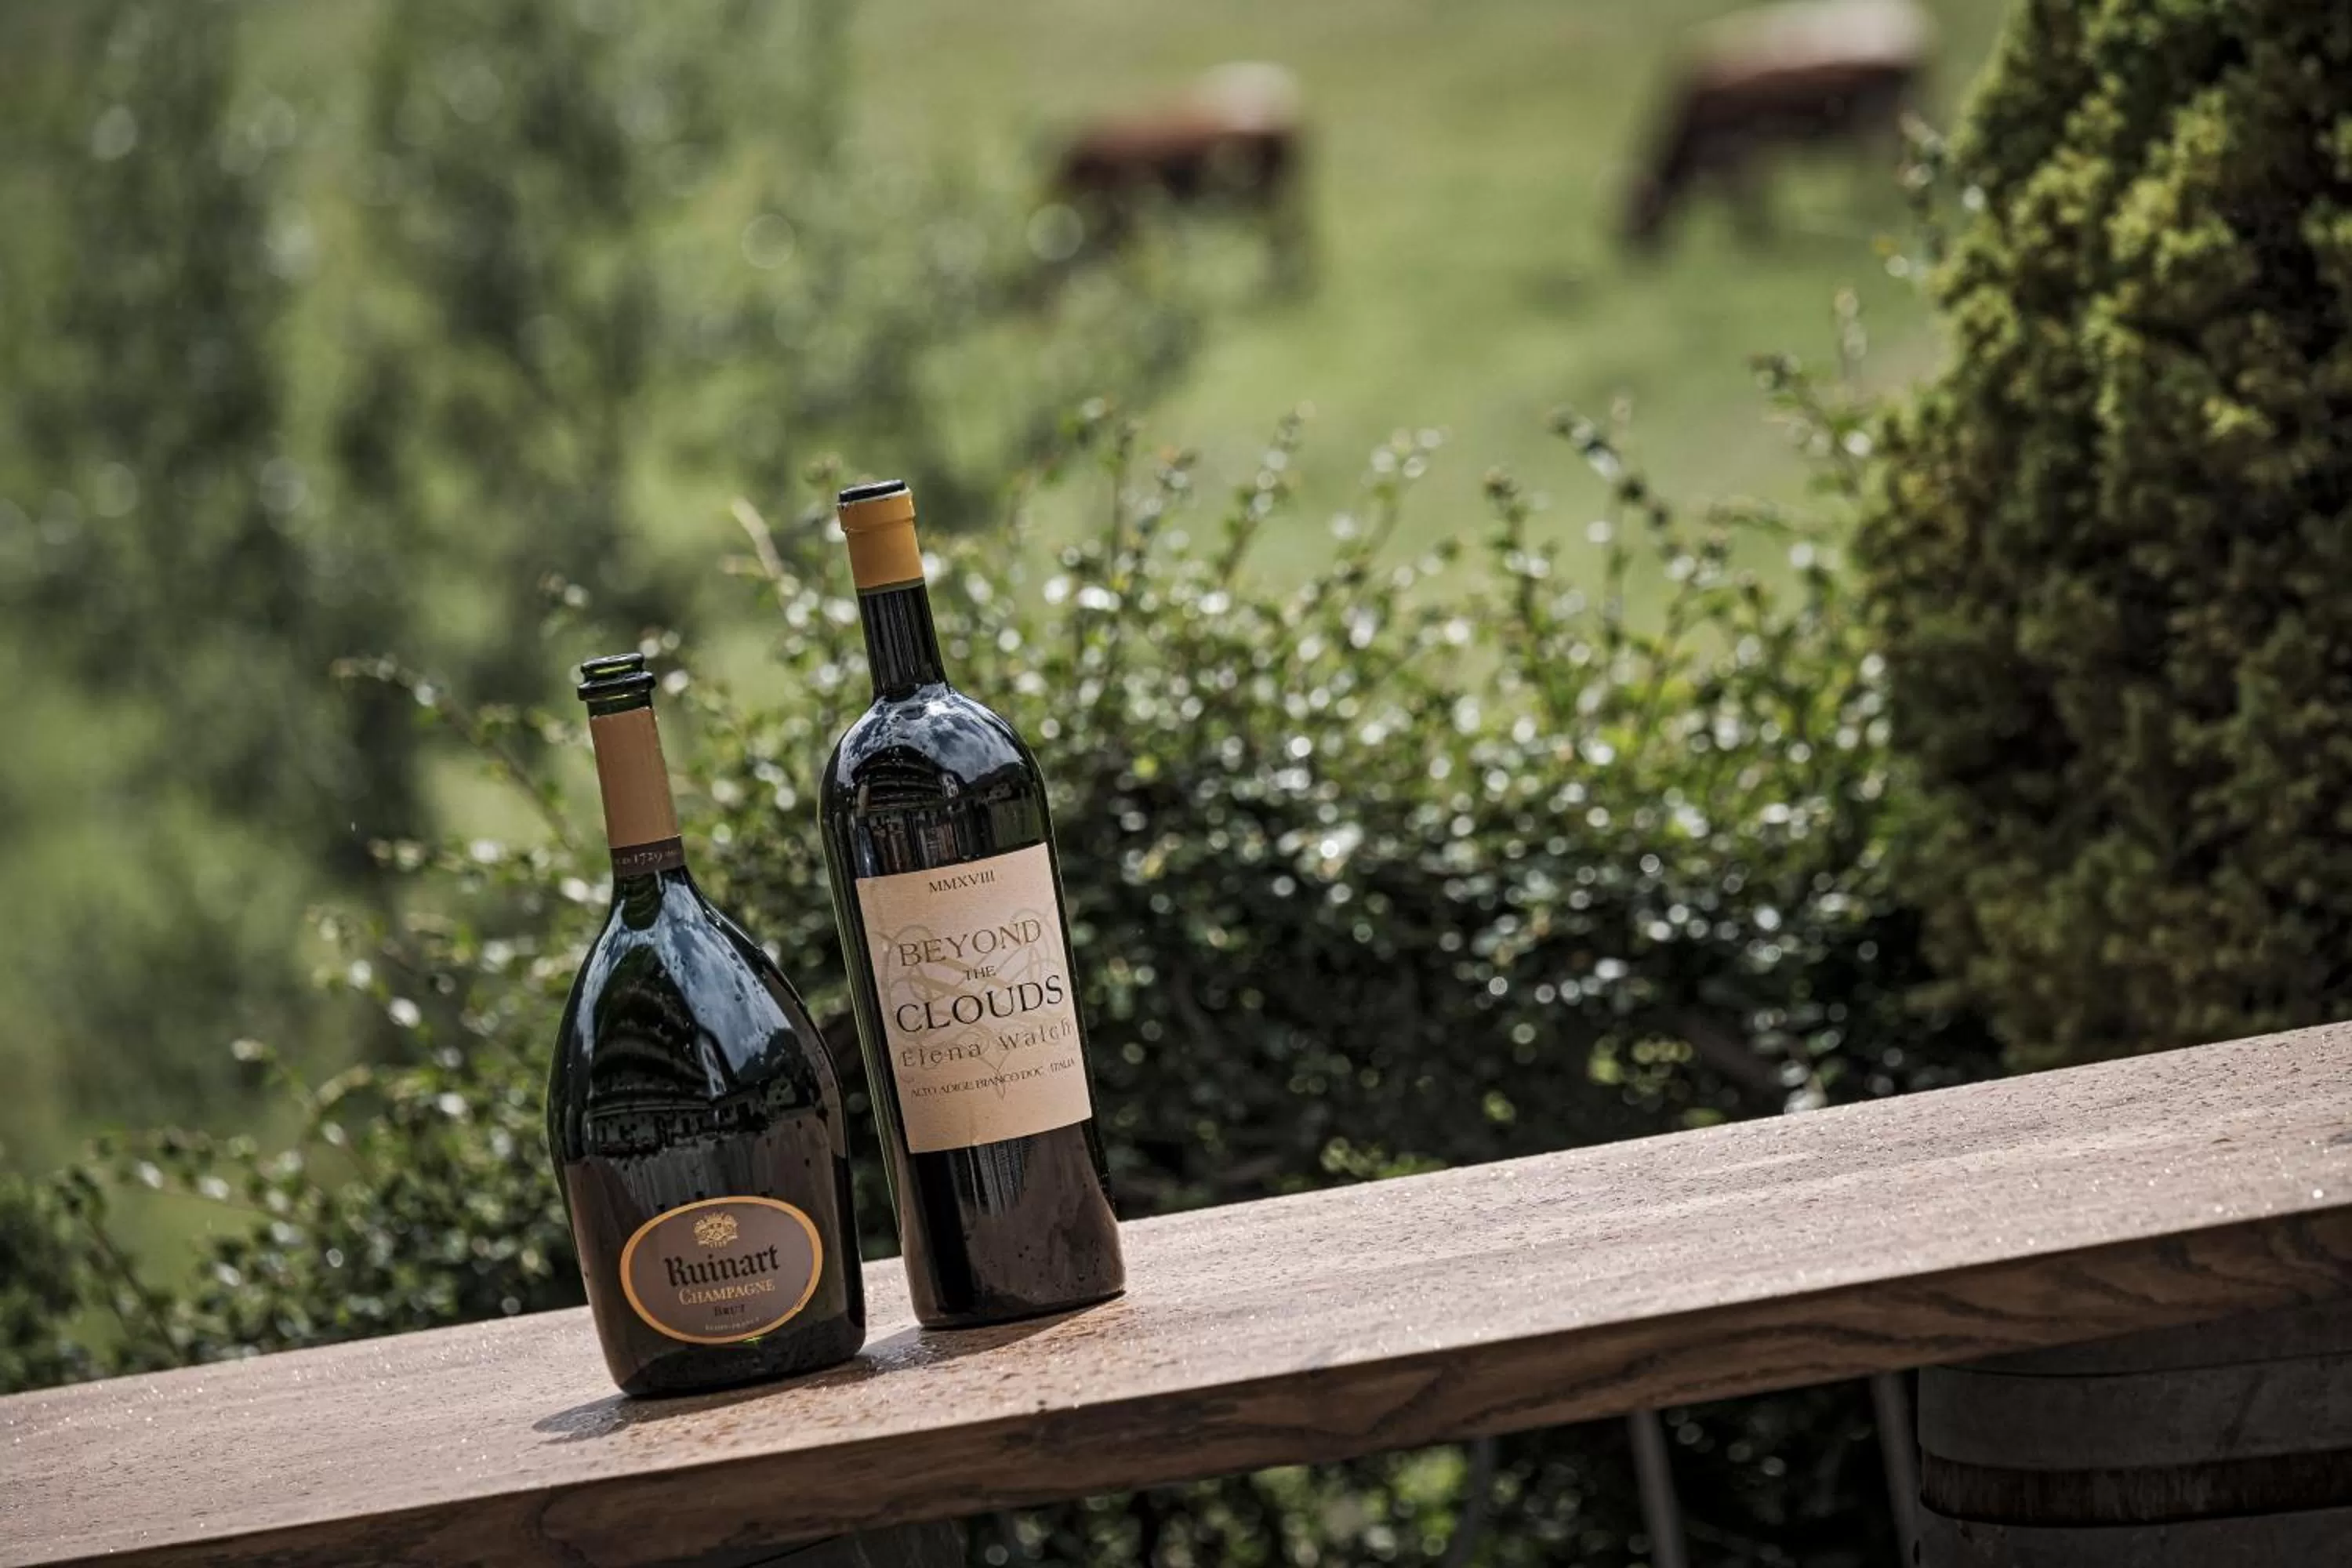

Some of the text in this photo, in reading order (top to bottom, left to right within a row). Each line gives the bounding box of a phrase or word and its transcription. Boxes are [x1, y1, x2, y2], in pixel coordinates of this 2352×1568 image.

[929, 869, 995, 893] MMXVIII
[898, 918, 1042, 967] BEYOND
[964, 965, 996, 982] THE
[895, 975, 1065, 1033] CLOUDS
[902, 1018, 1073, 1067] Elena Walch
[665, 1243, 779, 1286] Ruinart
[679, 1279, 776, 1305] CHAMPAGNE
